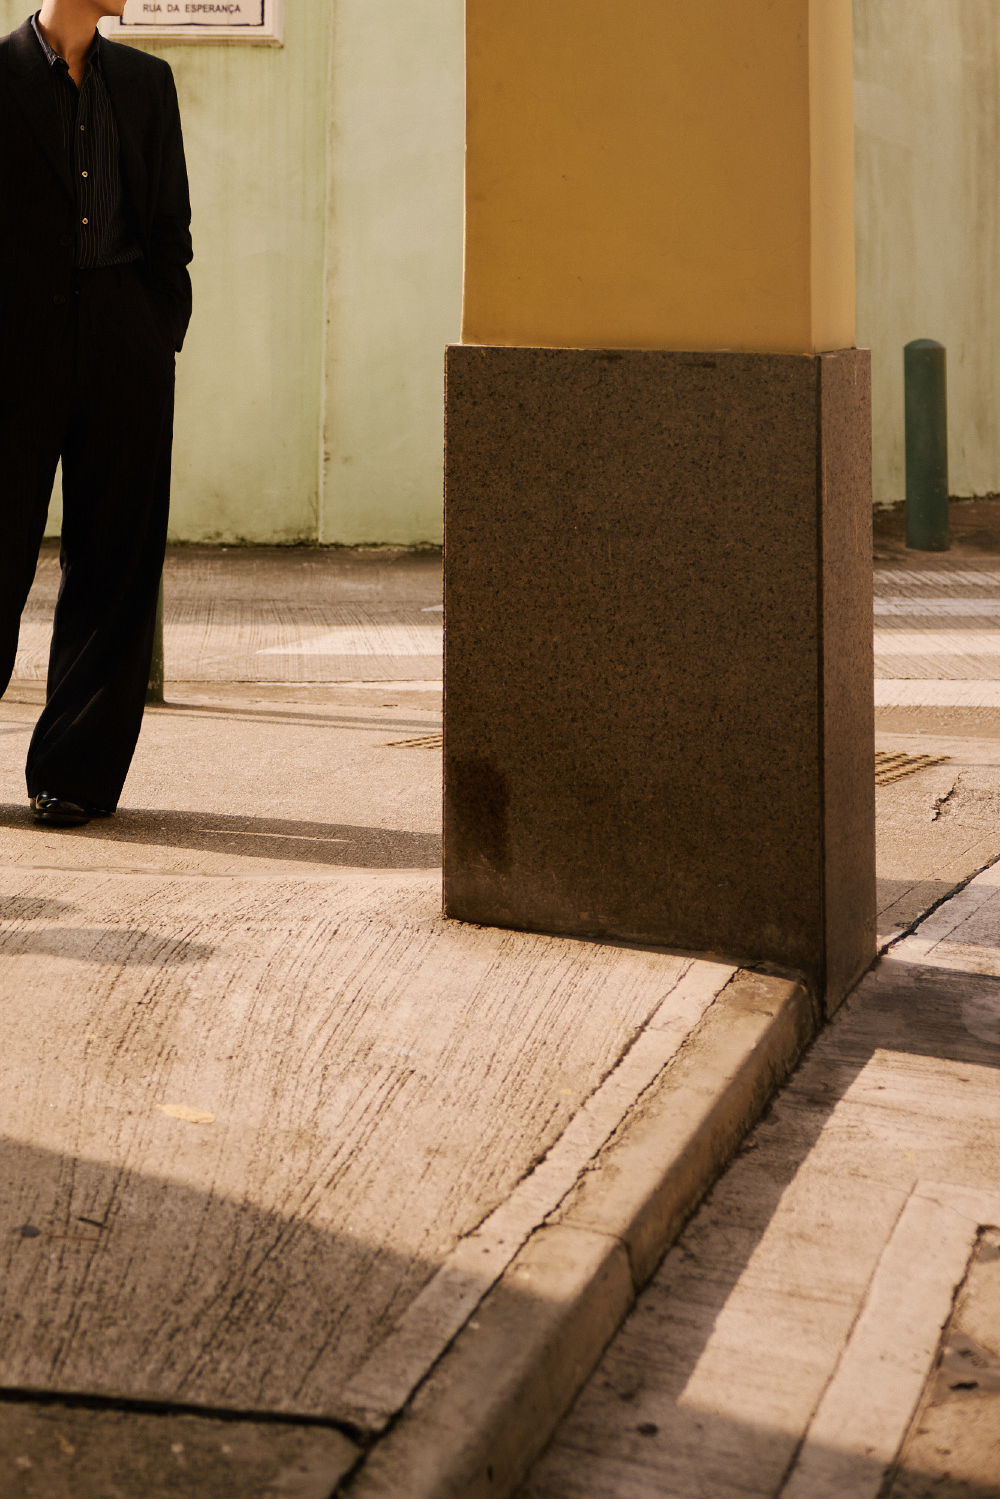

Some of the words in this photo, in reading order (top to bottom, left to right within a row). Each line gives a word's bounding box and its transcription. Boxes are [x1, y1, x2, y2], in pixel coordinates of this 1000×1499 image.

[143, 3, 162, 13] RUA
[167, 3, 180, 13] DA
[185, 3, 242, 15] ESPERANÇA
